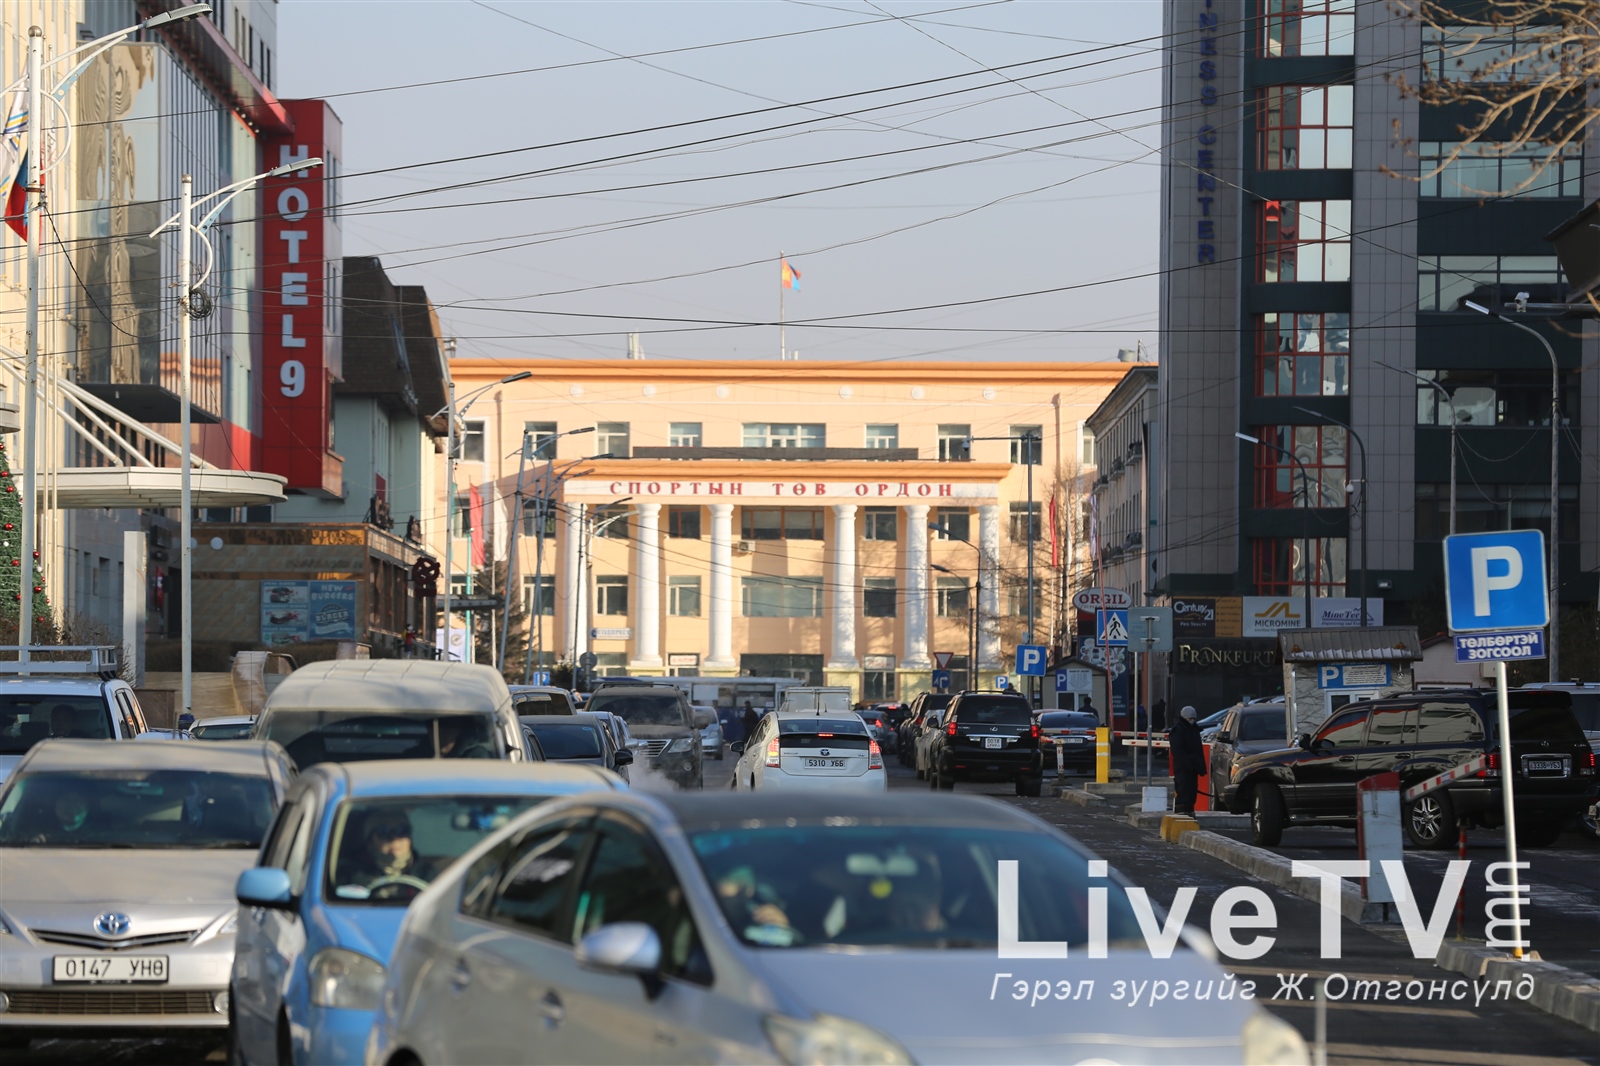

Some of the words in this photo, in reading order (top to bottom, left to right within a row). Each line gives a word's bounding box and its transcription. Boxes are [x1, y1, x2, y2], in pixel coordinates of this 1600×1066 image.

[1197, 125, 1216, 264] CENTER
[277, 145, 309, 348] HOTEL
[279, 359, 306, 398] 9
[610, 481, 743, 496] СПОРТЫН
[772, 482, 827, 496] ТӨВ
[855, 482, 953, 498] ОРДОН
[321, 584, 344, 592] NEW
[1471, 545, 1523, 617] P
[311, 592, 354, 601] BURGERS
[1079, 593, 1126, 605] ORGIL
[1174, 601, 1208, 614] Century
[1203, 608, 1214, 620] 21
[1254, 619, 1301, 628] MICROMINE
[1459, 632, 1539, 649] ТӨЛБӨРТЭЙ
[1023, 649, 1040, 671] P
[1179, 644, 1274, 667] FRANKFURT
[1468, 645, 1532, 660] ЗОГСООЛ
[997, 676, 1006, 688] P
[1057, 673, 1066, 687] P
[1321, 666, 1339, 687] P
[65, 959, 112, 978] 0147
[129, 959, 164, 977] УНӨ
